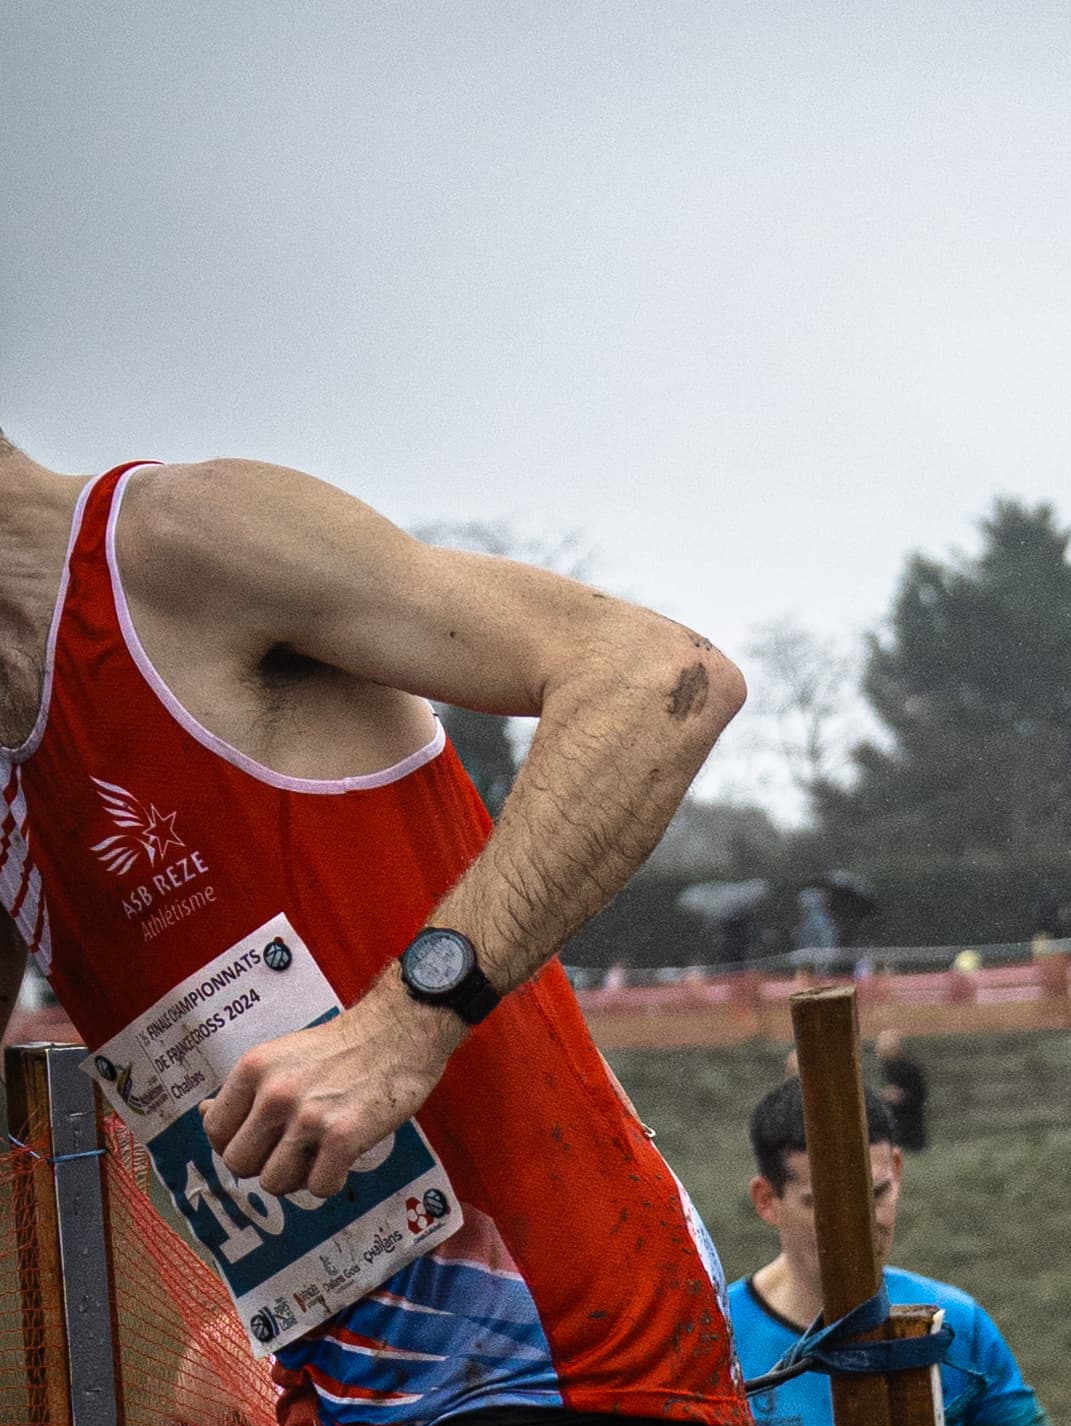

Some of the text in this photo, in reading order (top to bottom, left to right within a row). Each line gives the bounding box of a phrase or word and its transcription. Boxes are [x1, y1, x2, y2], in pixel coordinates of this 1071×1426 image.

[121, 850, 209, 919] ASB REZE
[141, 886, 217, 942] Athlétisme
[146, 1013, 172, 1041] FINALE
[169, 948, 262, 1027] CHAMPIONNATS
[154, 988, 261, 1074] DE FRANCE CROSS 2024
[170, 1071, 206, 1100] Challans
[184, 1131, 396, 1264] 16
